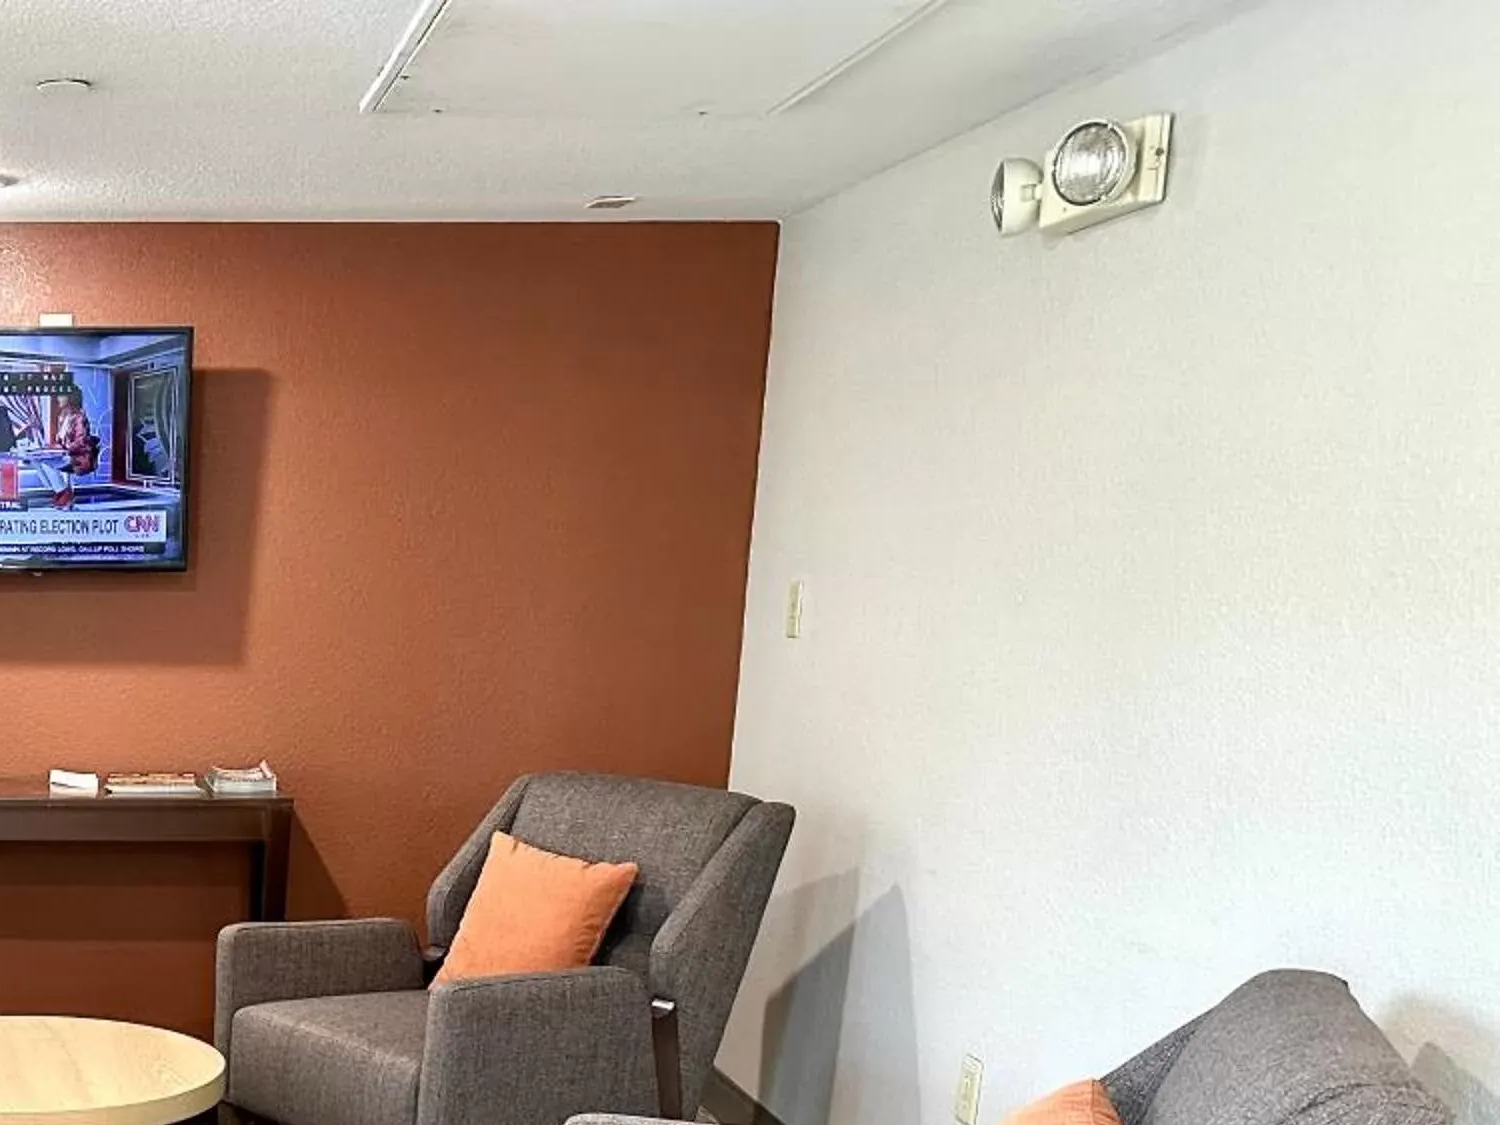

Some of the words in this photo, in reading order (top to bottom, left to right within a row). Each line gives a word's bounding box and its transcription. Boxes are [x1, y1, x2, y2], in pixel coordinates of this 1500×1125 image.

[39, 519, 90, 535] ELECTION
[92, 519, 119, 535] PLOT
[124, 515, 160, 533] CNN
